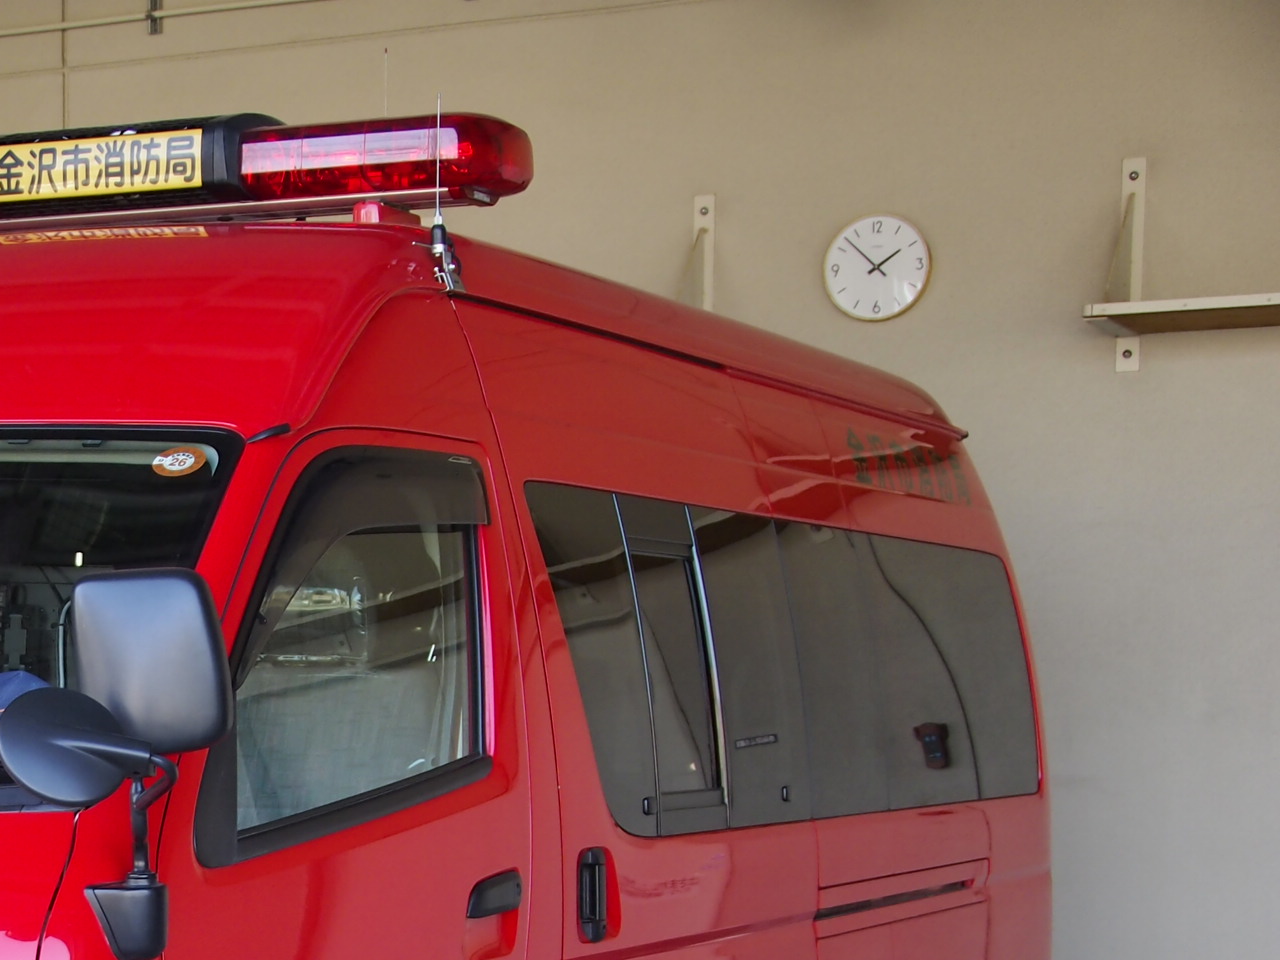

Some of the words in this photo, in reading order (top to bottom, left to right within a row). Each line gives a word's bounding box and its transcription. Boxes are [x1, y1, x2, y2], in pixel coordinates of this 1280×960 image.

[872, 220, 883, 234] 12
[831, 263, 840, 278] 9
[915, 257, 925, 271] 3
[872, 300, 881, 314] 6
[168, 457, 188, 467] 26
